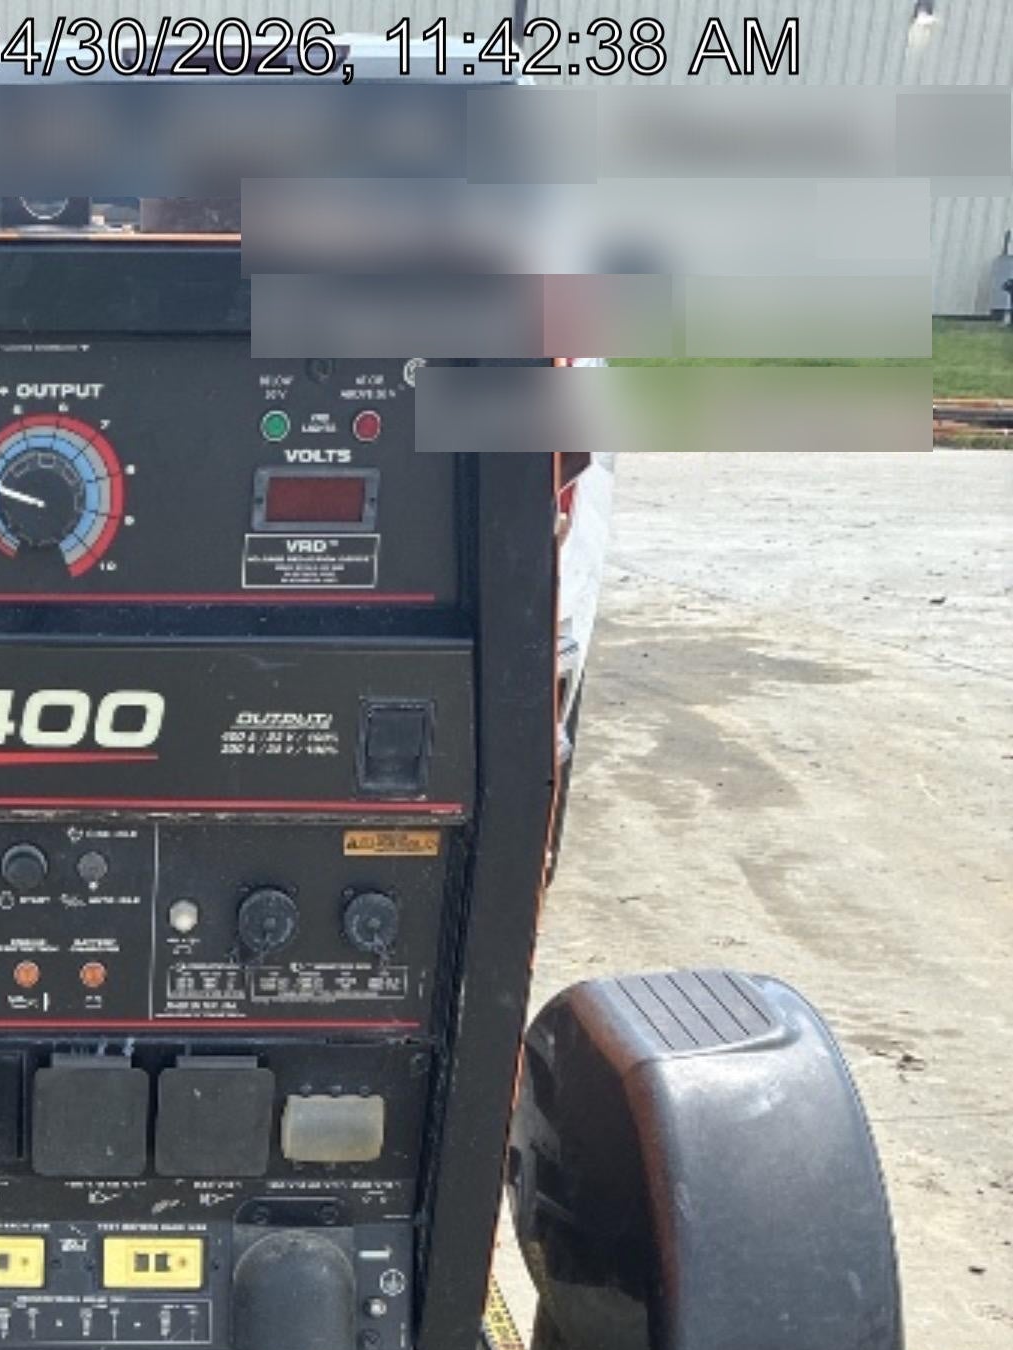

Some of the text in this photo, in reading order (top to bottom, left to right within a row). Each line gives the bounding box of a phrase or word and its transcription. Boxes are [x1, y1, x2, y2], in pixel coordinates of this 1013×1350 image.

[15, 382, 104, 399] OUTPUT
[100, 418, 111, 430] 7
[284, 448, 352, 464] VOLTS
